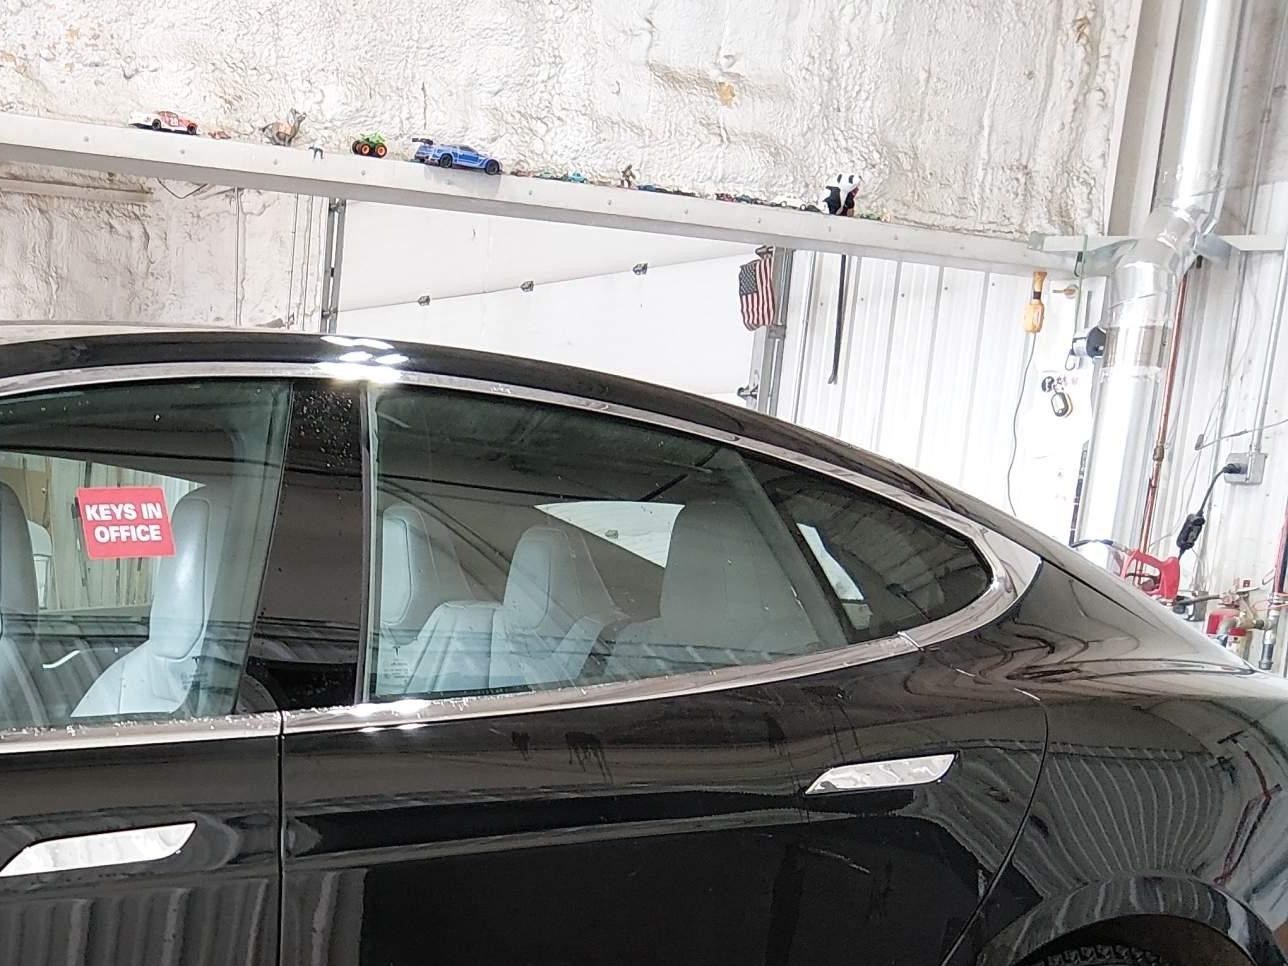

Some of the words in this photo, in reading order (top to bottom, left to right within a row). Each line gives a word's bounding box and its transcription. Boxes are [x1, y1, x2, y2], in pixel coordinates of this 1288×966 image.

[85, 503, 137, 521] KEYS
[141, 502, 163, 520] IN
[94, 525, 162, 543] OFFICE
